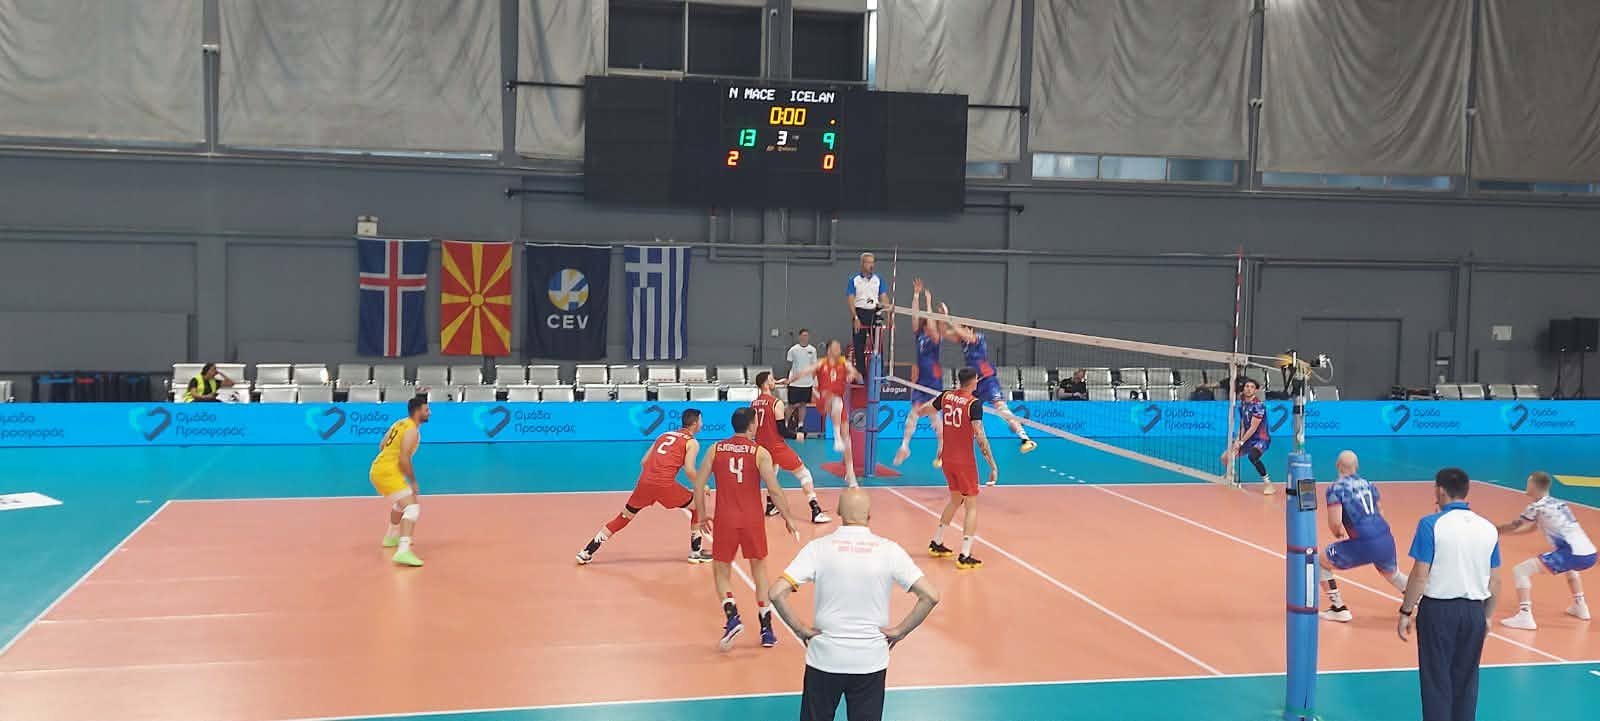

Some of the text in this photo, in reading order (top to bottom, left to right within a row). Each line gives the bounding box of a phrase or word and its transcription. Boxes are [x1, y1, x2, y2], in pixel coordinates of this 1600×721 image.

[729, 88, 776, 101] N MACE
[790, 91, 835, 103] ICELAN
[769, 107, 806, 125] 0:00
[739, 129, 757, 147] 13
[777, 130, 788, 146] 3
[823, 132, 835, 149] 9
[728, 151, 739, 165] 2
[823, 155, 834, 169] 0
[547, 314, 588, 329] CEV
[0, 411, 36, 424] μάδα
[944, 404, 962, 428] 20
[0, 427, 65, 440] ροσφοράς
[657, 436, 676, 455] 2
[729, 457, 744, 483] 4
